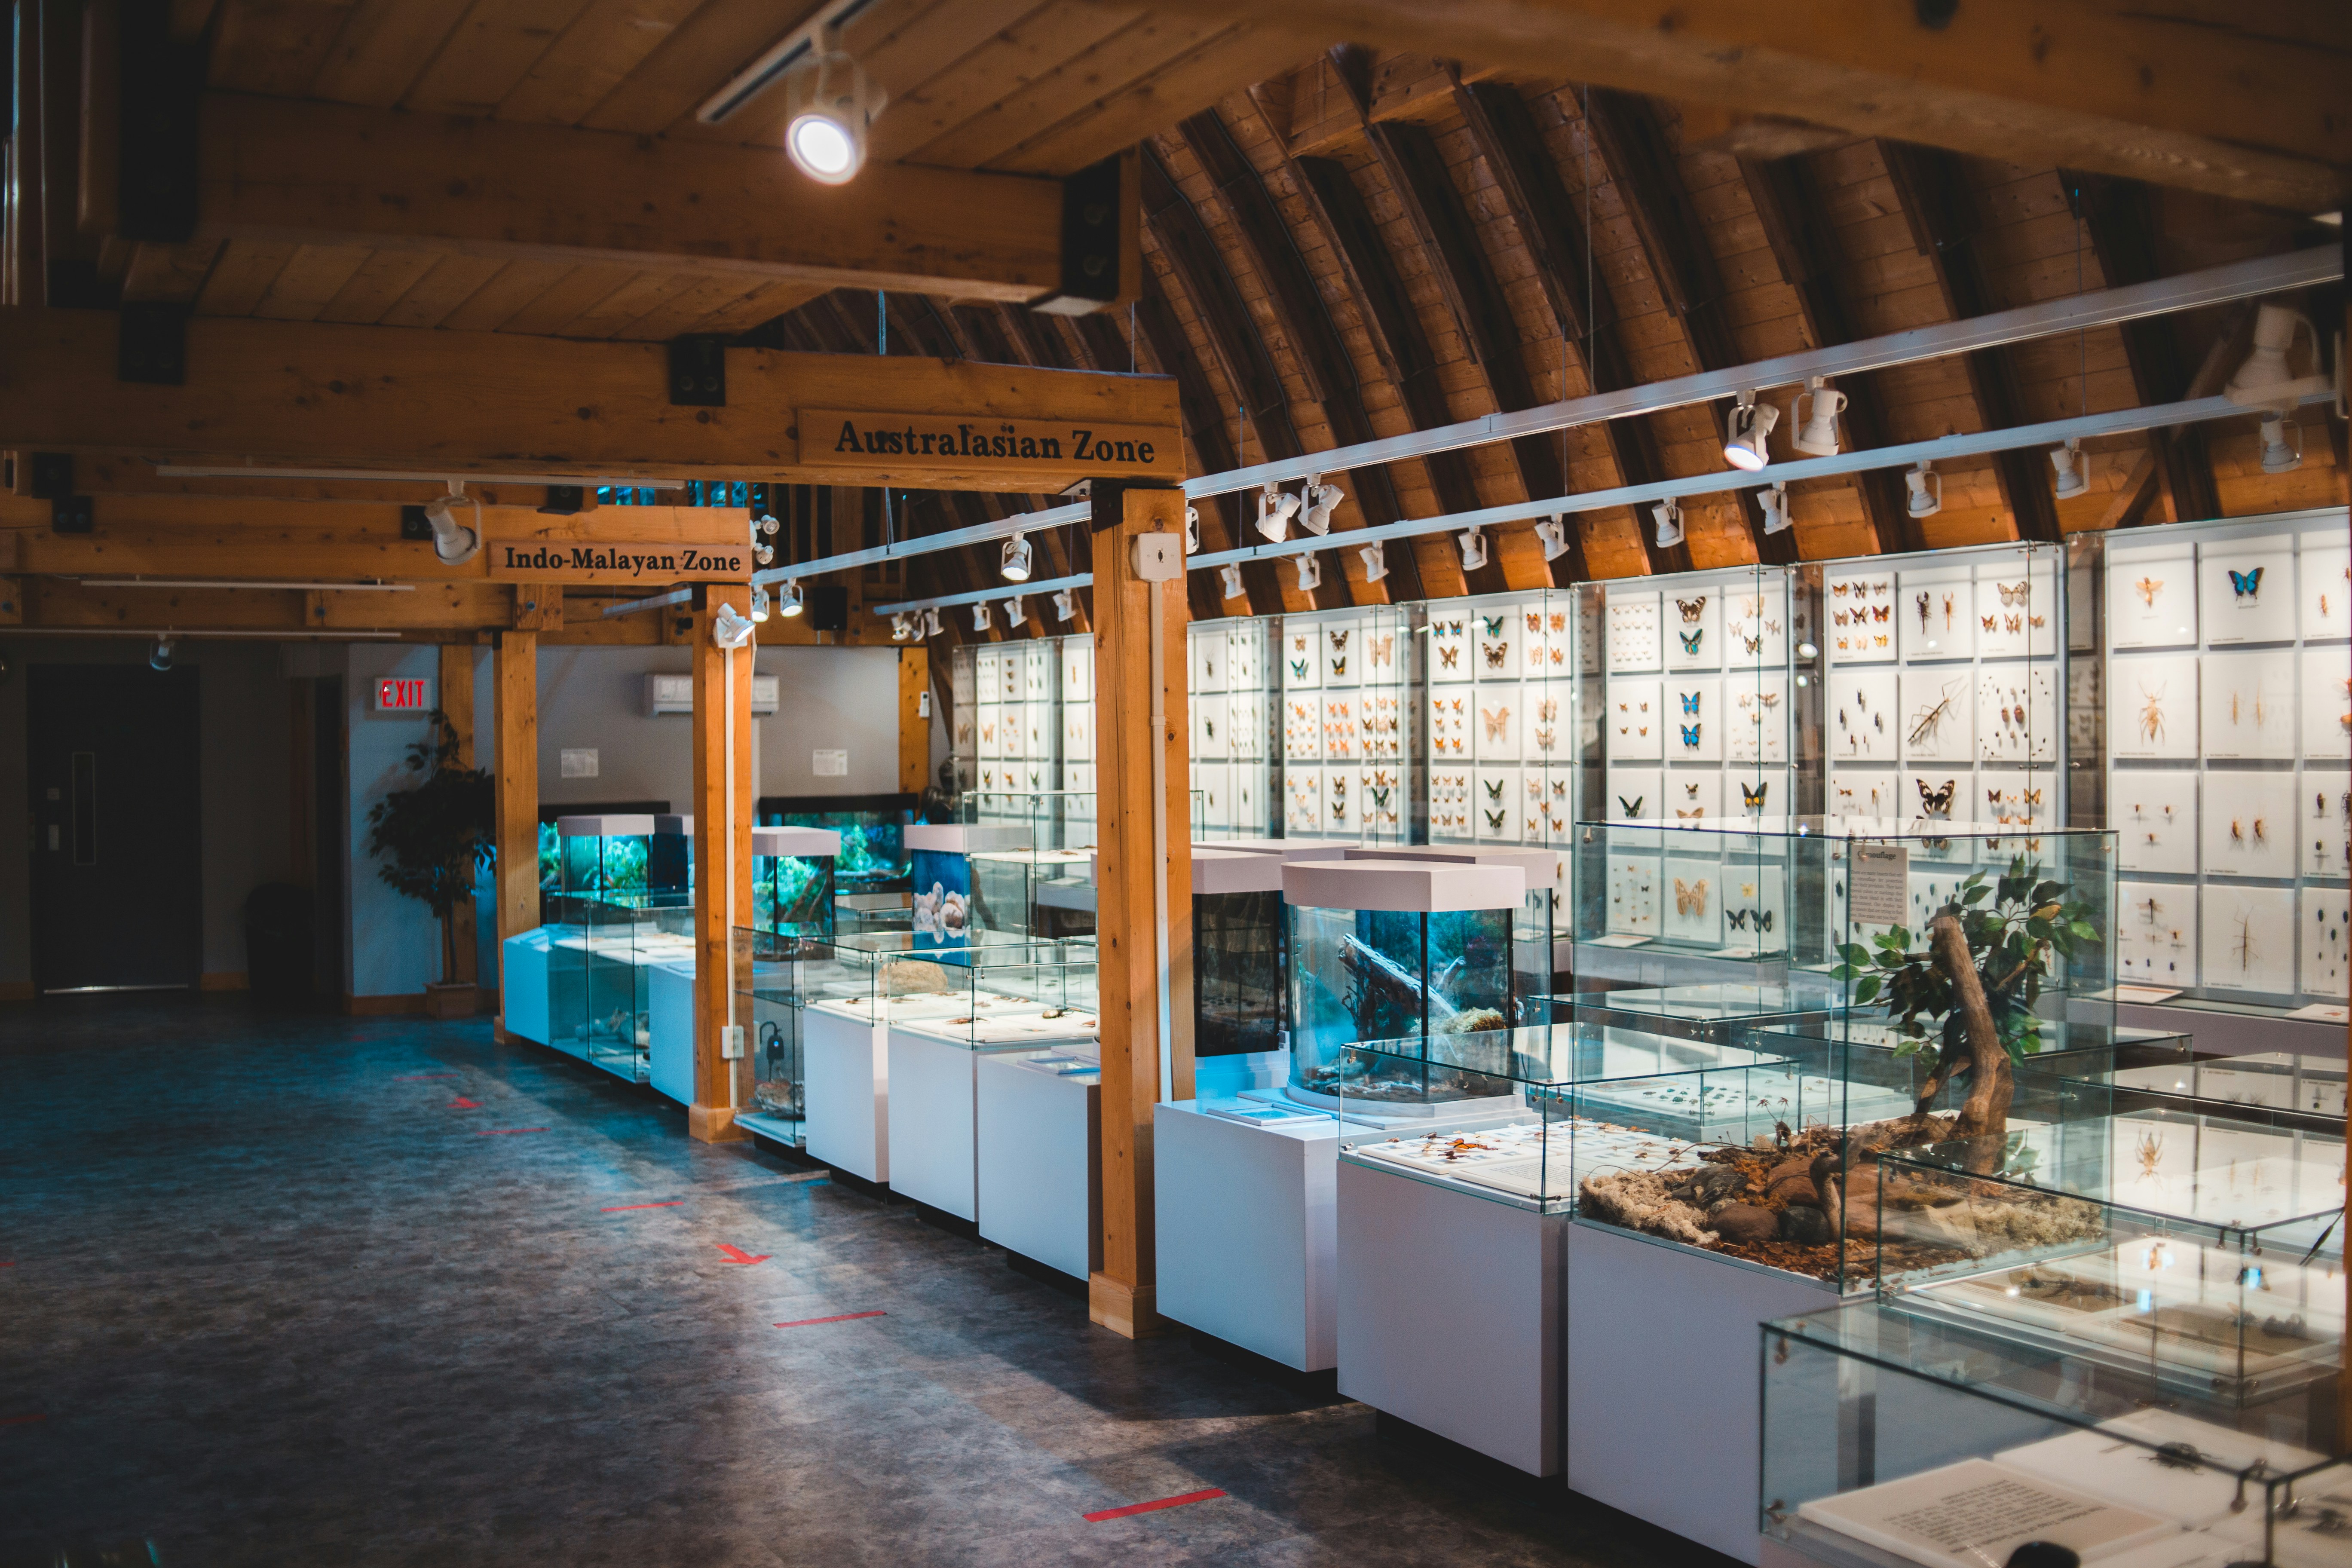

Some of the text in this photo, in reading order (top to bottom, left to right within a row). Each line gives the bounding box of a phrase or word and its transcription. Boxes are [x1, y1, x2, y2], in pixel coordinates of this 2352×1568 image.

[835, 420, 1155, 462] Australasian Zone
[505, 547, 741, 576] Indo-Malayan Zone
[382, 680, 425, 707] EXIT
[1857, 850, 1897, 861] Cmouflage
